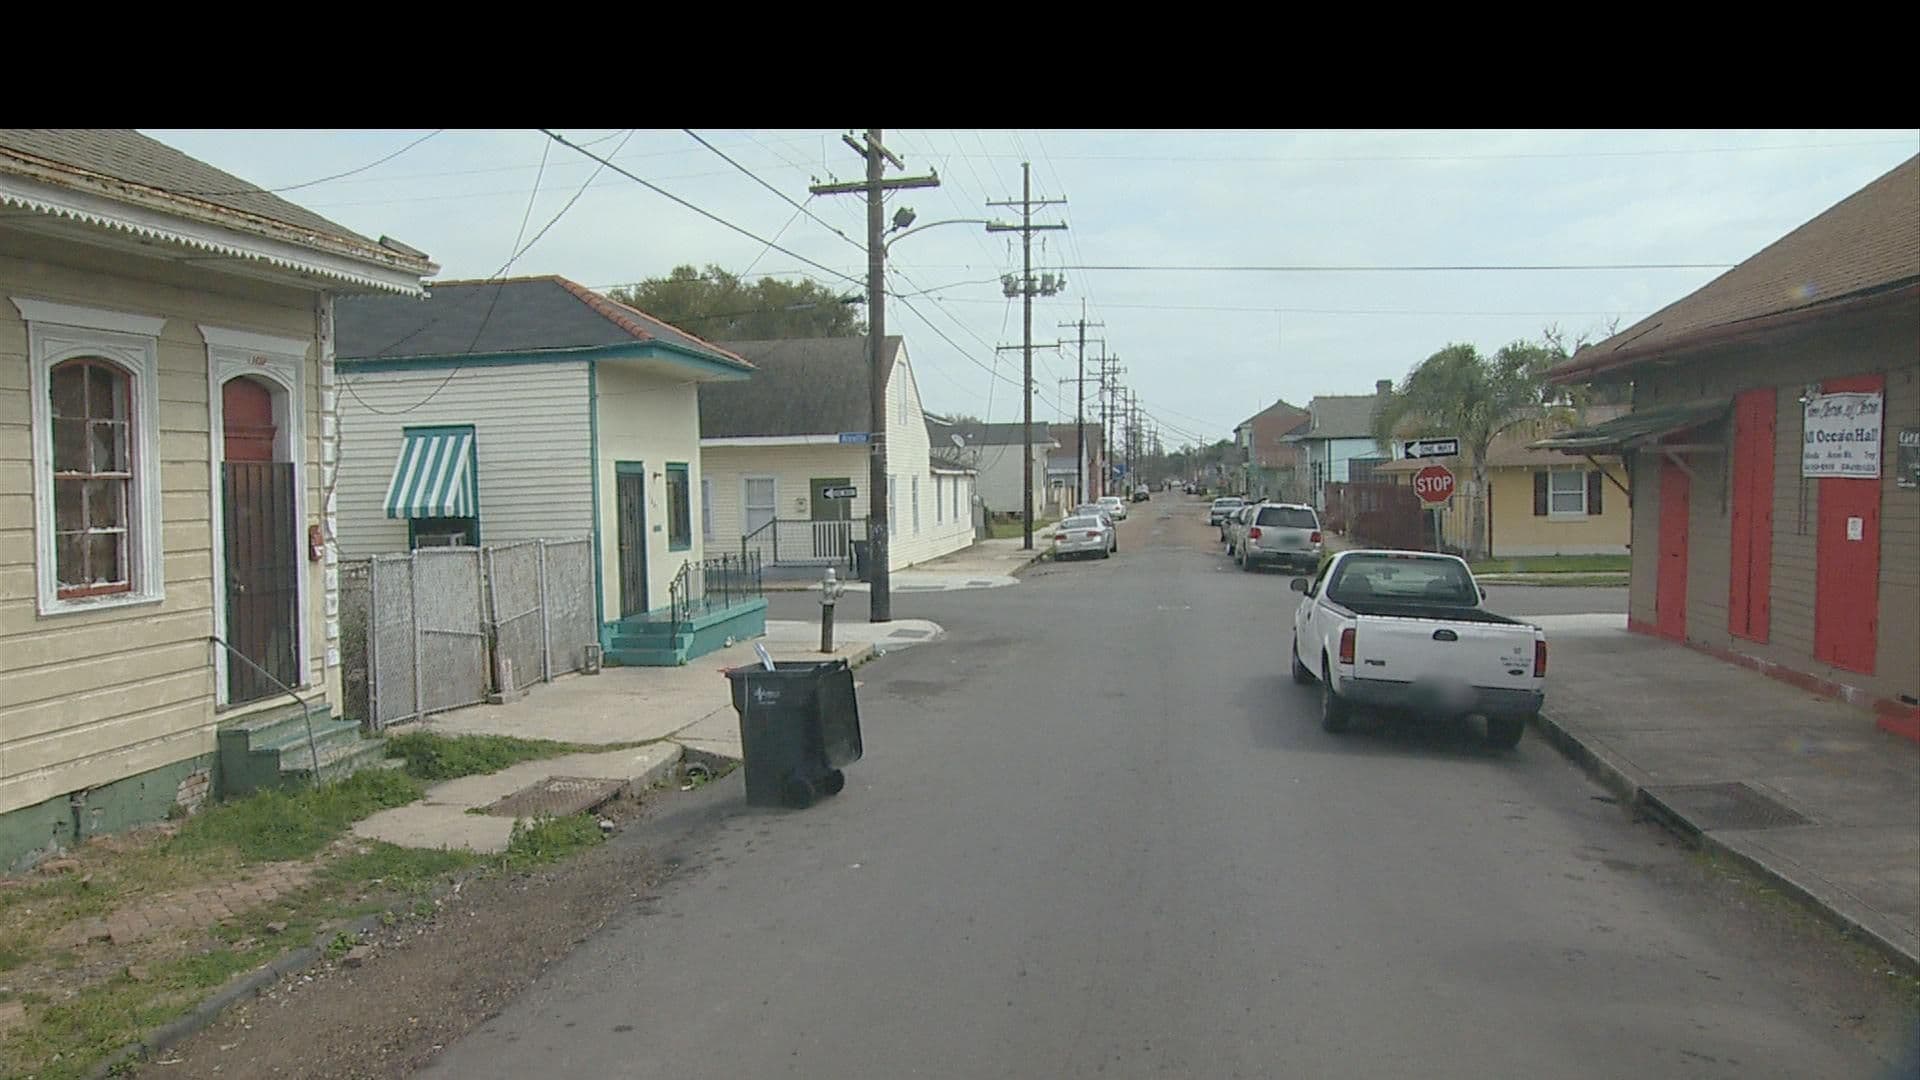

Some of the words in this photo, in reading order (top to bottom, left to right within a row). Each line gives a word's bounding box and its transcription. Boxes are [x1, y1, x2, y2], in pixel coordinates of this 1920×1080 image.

[1855, 428, 1879, 442] Hall
[1420, 443, 1435, 454] ONE
[1437, 443, 1453, 453] WAY
[1417, 476, 1452, 492] STOP
